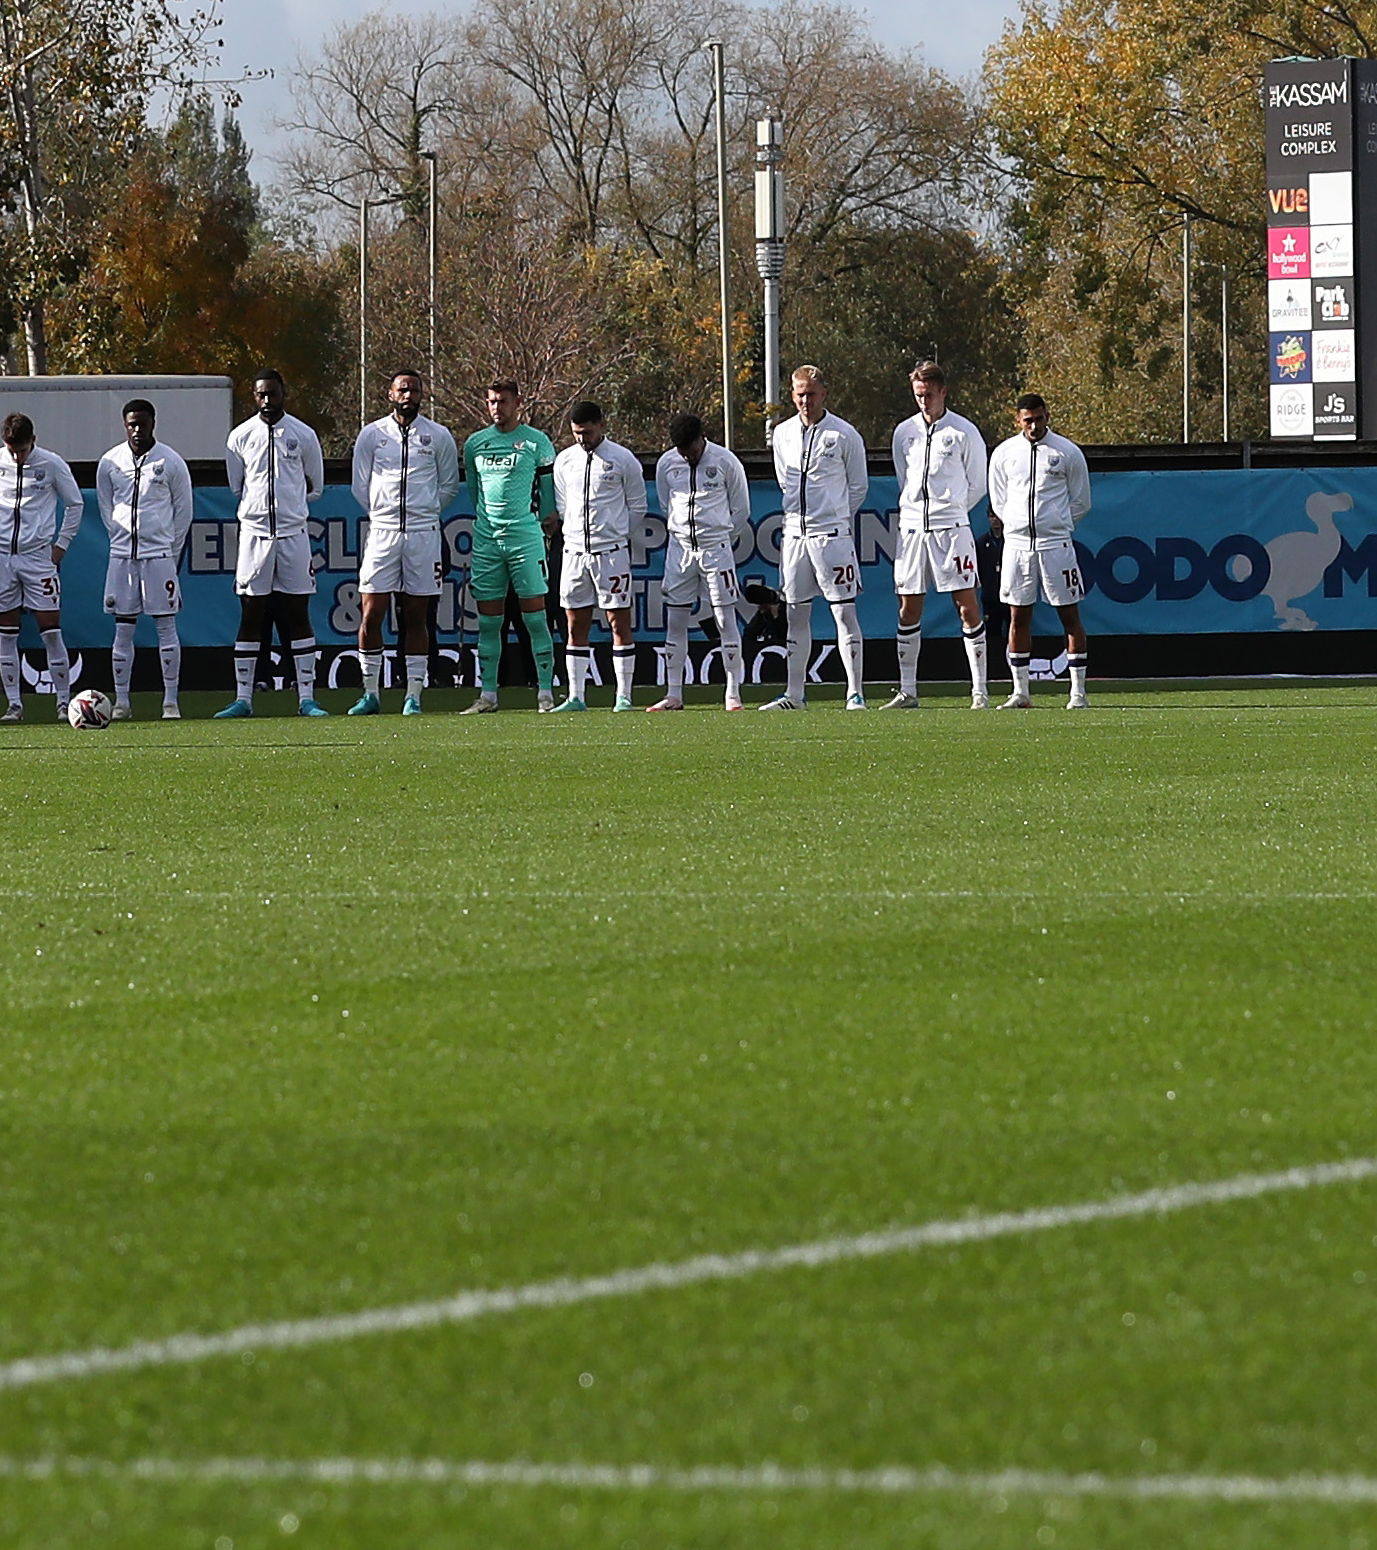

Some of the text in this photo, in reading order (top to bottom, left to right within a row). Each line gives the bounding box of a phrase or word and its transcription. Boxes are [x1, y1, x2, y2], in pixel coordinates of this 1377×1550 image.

[1277, 81, 1347, 107] KASSAM
[1284, 122, 1332, 138] LEISURE
[1280, 140, 1337, 156] COMPLEX
[1272, 251, 1307, 266] hollywood
[1281, 264, 1299, 275] bowl
[1315, 285, 1345, 303] Park
[1272, 308, 1309, 318] GRAVITEE
[1316, 340, 1351, 354] Frankie
[1277, 404, 1306, 416] RIDGE
[1314, 415, 1355, 424] SPORTS BAR
[483, 453, 517, 467] ideal
[433, 561, 443, 581] 5
[538, 560, 547, 579] 1
[953, 554, 975, 573] 14
[833, 564, 855, 586] 20
[1062, 569, 1080, 588] 18
[41, 576, 60, 596] 31
[164, 579, 177, 600] 9
[608, 574, 631, 595] 27
